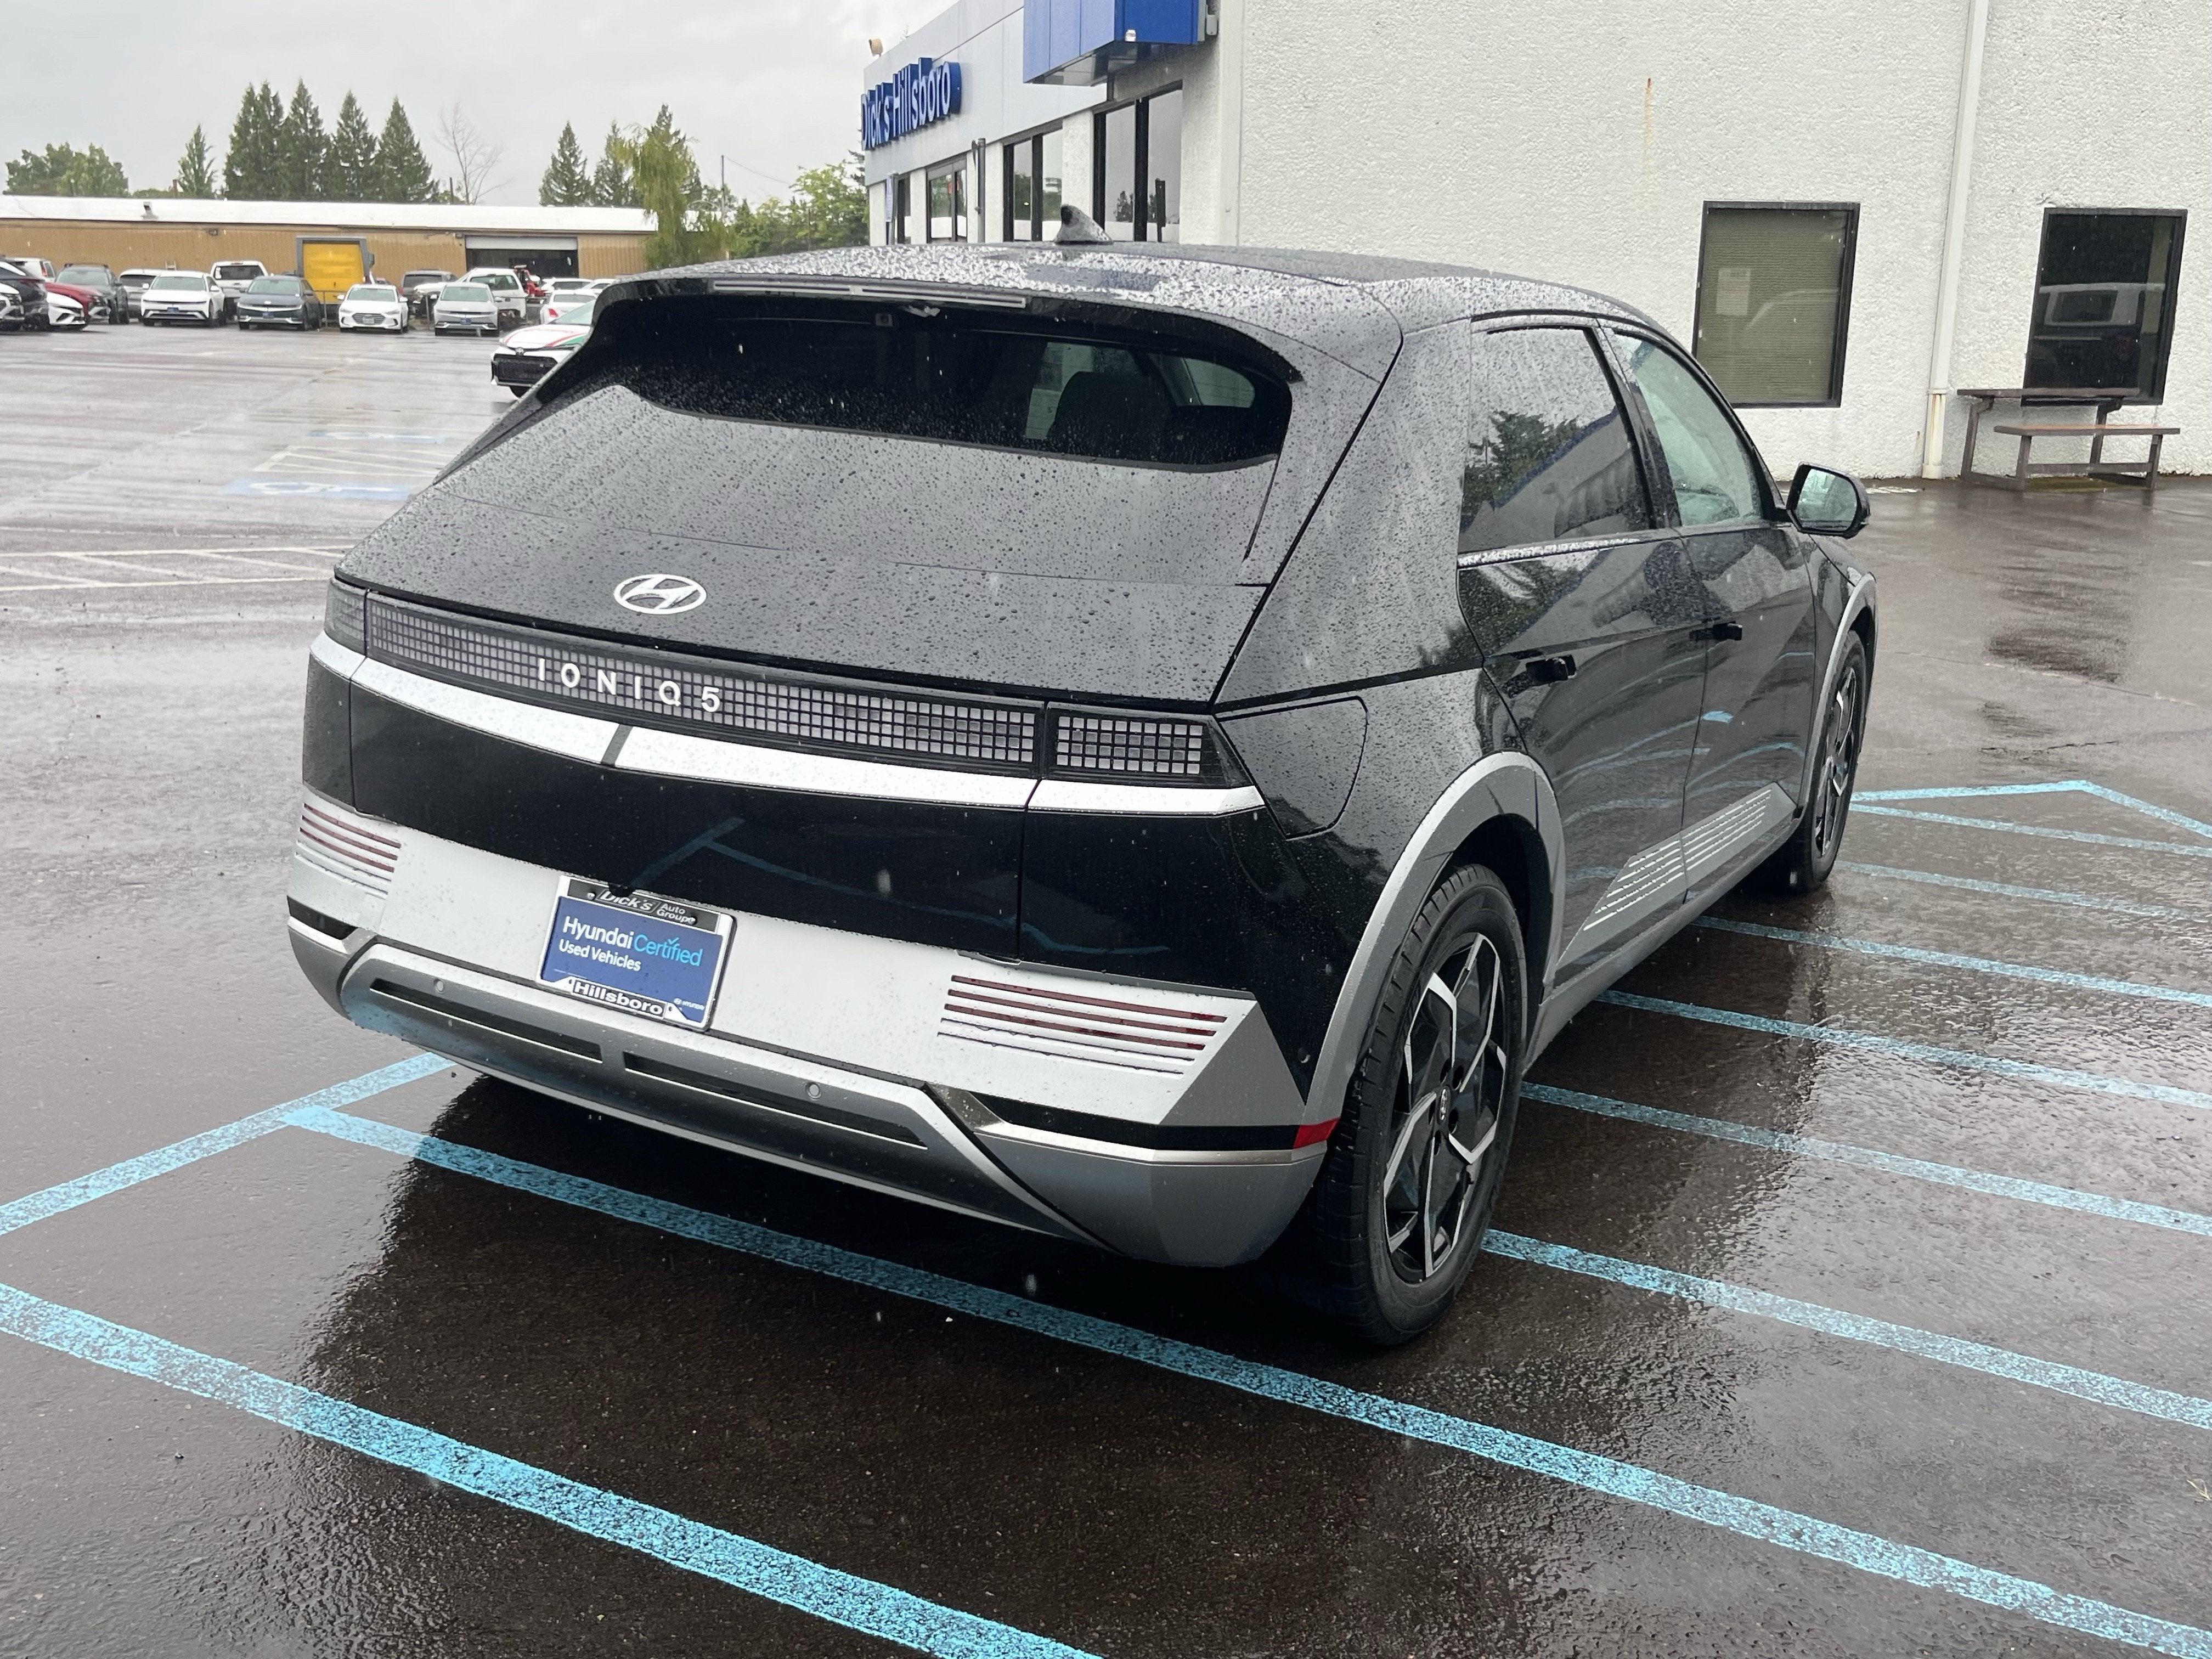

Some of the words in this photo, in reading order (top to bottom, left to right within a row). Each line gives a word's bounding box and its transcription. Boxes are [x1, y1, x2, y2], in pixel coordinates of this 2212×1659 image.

[861, 82, 891, 151] Dick's
[893, 57, 952, 137] Hillsboro
[538, 658, 681, 707] IONIQ
[701, 686, 721, 713] 5
[656, 909, 690, 923] Group
[661, 902, 686, 915] Auto
[559, 939, 591, 958] Used
[591, 947, 642, 972] Vehicles
[562, 916, 634, 949] Hyundai
[634, 934, 703, 967] Certified
[574, 979, 663, 1015] Hillsboro
